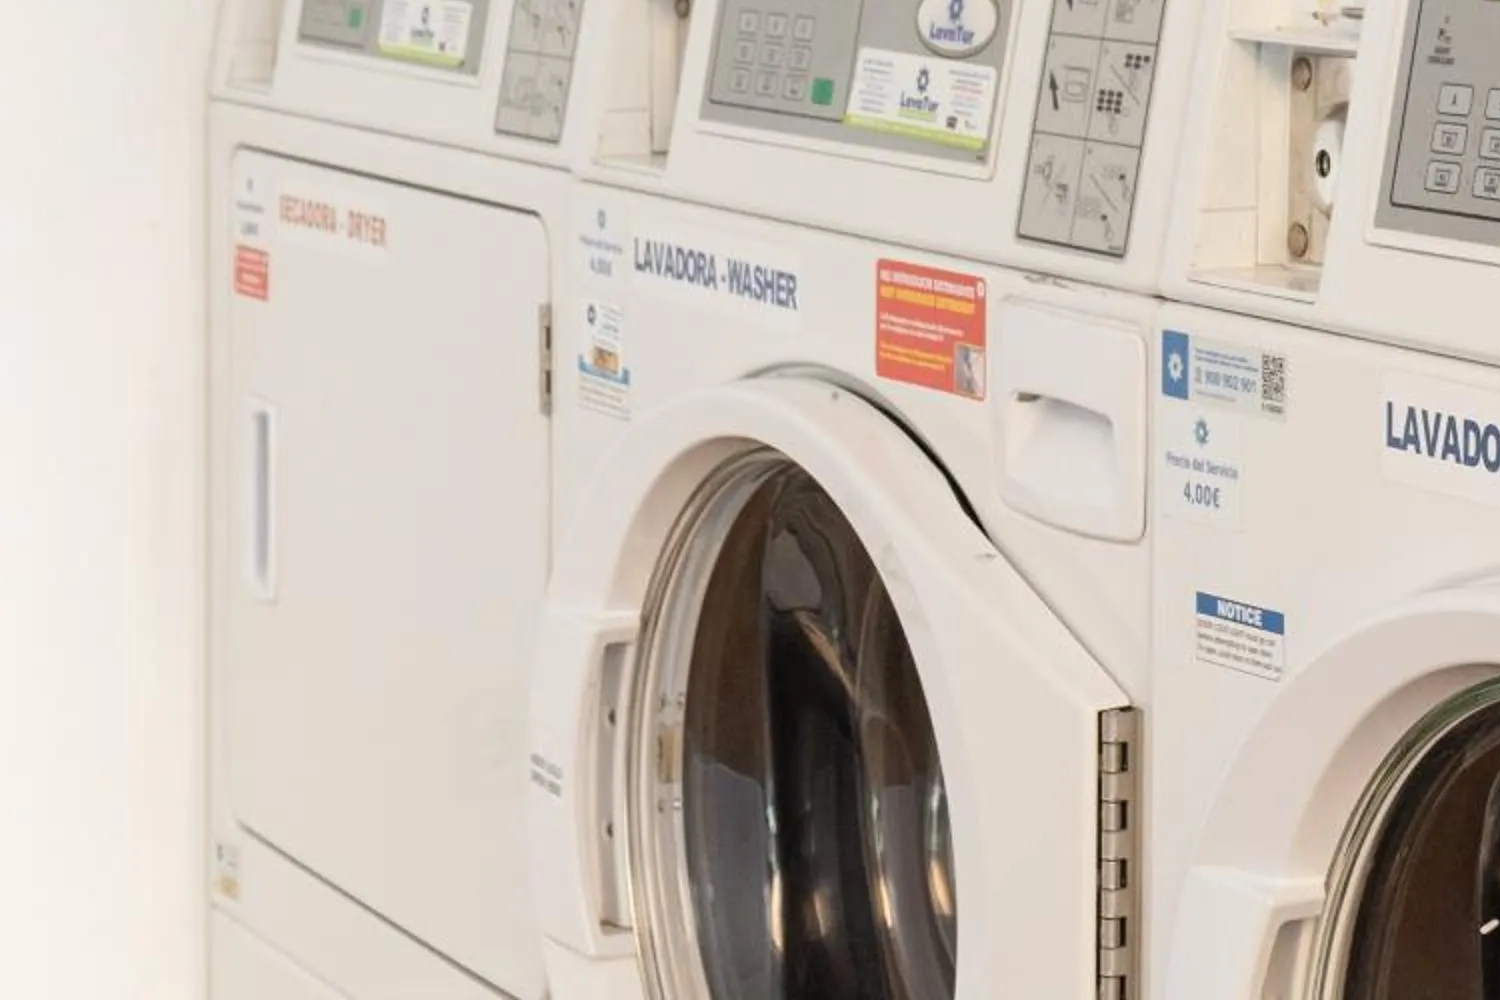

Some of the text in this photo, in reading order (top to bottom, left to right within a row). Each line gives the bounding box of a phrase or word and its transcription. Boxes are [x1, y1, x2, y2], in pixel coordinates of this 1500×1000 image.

[634, 236, 717, 291] LAVADORA
[727, 257, 797, 310] WASHER
[1217, 600, 1263, 627] NOTICE
